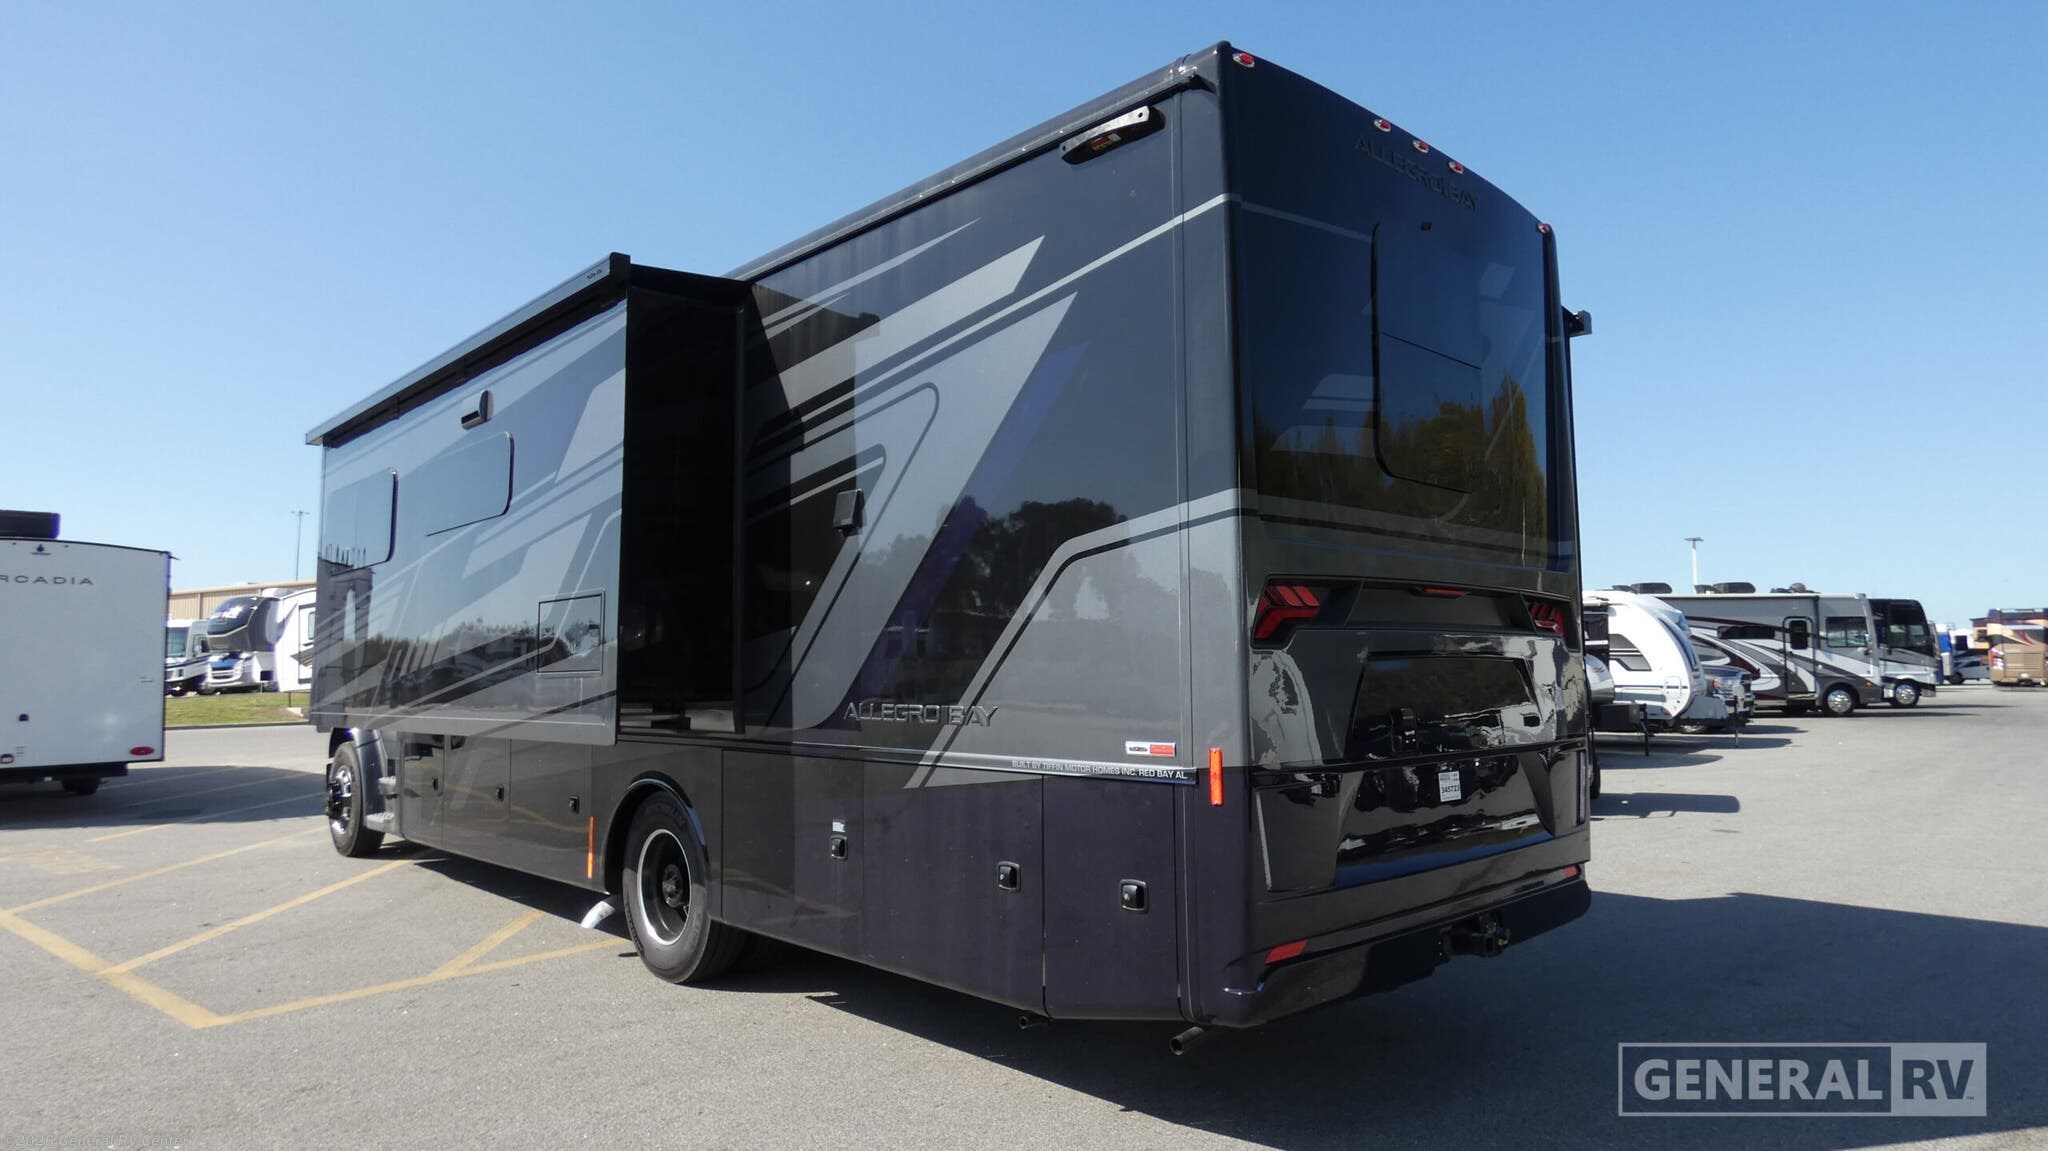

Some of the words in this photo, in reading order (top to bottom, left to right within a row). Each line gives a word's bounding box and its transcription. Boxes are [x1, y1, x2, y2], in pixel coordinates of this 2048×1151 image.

[843, 702, 940, 723] ALLEGRO
[948, 704, 999, 727] BAY
[1012, 760, 1031, 769] BUILT
[1031, 761, 1041, 769] BY
[1043, 762, 1064, 771] TIFFIN
[1064, 763, 1091, 773] MOTOR
[1092, 766, 1120, 775] HOMES
[1138, 768, 1155, 777] RED
[1156, 769, 1175, 779] BAY
